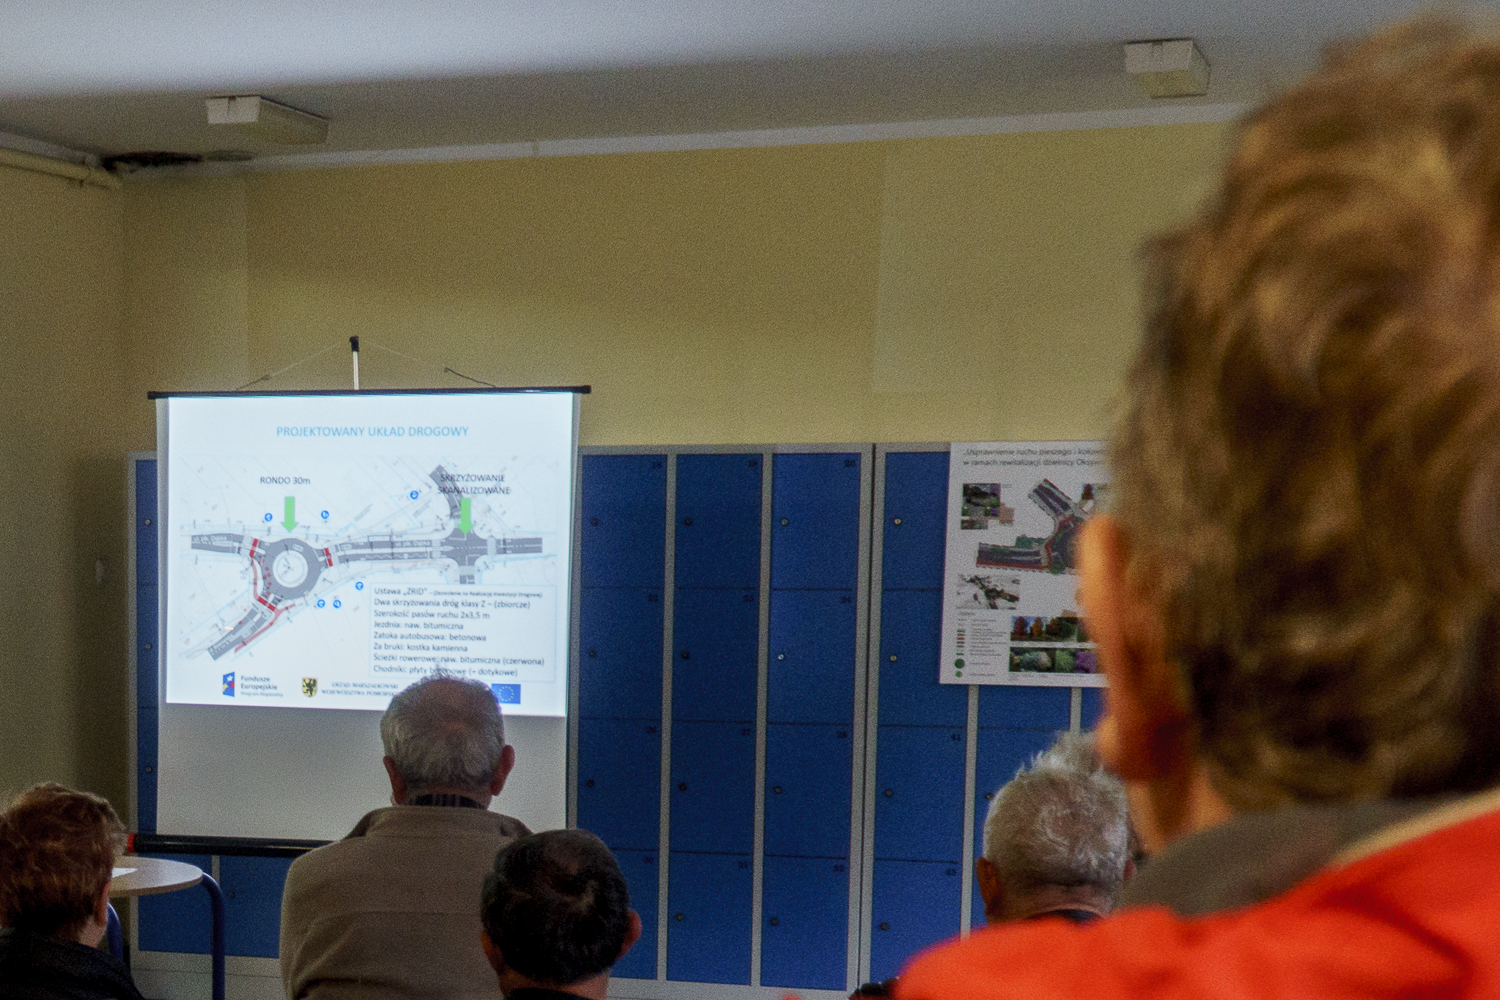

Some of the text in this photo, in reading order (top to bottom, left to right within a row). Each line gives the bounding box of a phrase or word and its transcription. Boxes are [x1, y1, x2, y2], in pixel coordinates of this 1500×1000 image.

[276, 426, 469, 437] PROJEKTOWANY UKŁAD DROGOWY
[260, 476, 311, 485] RONDO 30m
[440, 472, 505, 483] SKRZYŻOWANIE
[437, 486, 511, 495] SKANALIZOWANE
[374, 587, 401, 595] Ustawa
[374, 598, 390, 606] Dwa
[392, 598, 440, 608] skrzyżowania
[442, 599, 459, 608] dróg
[461, 599, 479, 609] klasy
[481, 600, 486, 608] Z
[494, 600, 531, 609] (zbiorcze)
[374, 610, 410, 618] Szerokość
[411, 610, 435, 619] pasów
[437, 611, 459, 619] ruchu
[460, 611, 481, 620] 2x3,5
[374, 621, 403, 629] Jezdnia:
[423, 622, 464, 630] bitumiczna
[400, 632, 447, 640] autobusowa:
[449, 633, 487, 641] betonowa
[407, 643, 430, 651] kostka
[432, 644, 468, 652] kamienna
[460, 656, 501, 665] bitumiczna
[502, 657, 545, 666] (czerwona)
[373, 665, 407, 673] Chodniki:
[409, 665, 428, 675] płyty
[479, 667, 518, 677] dotykowe)
[240, 675, 270, 683] Fundusze
[240, 683, 278, 691] Europejskie
